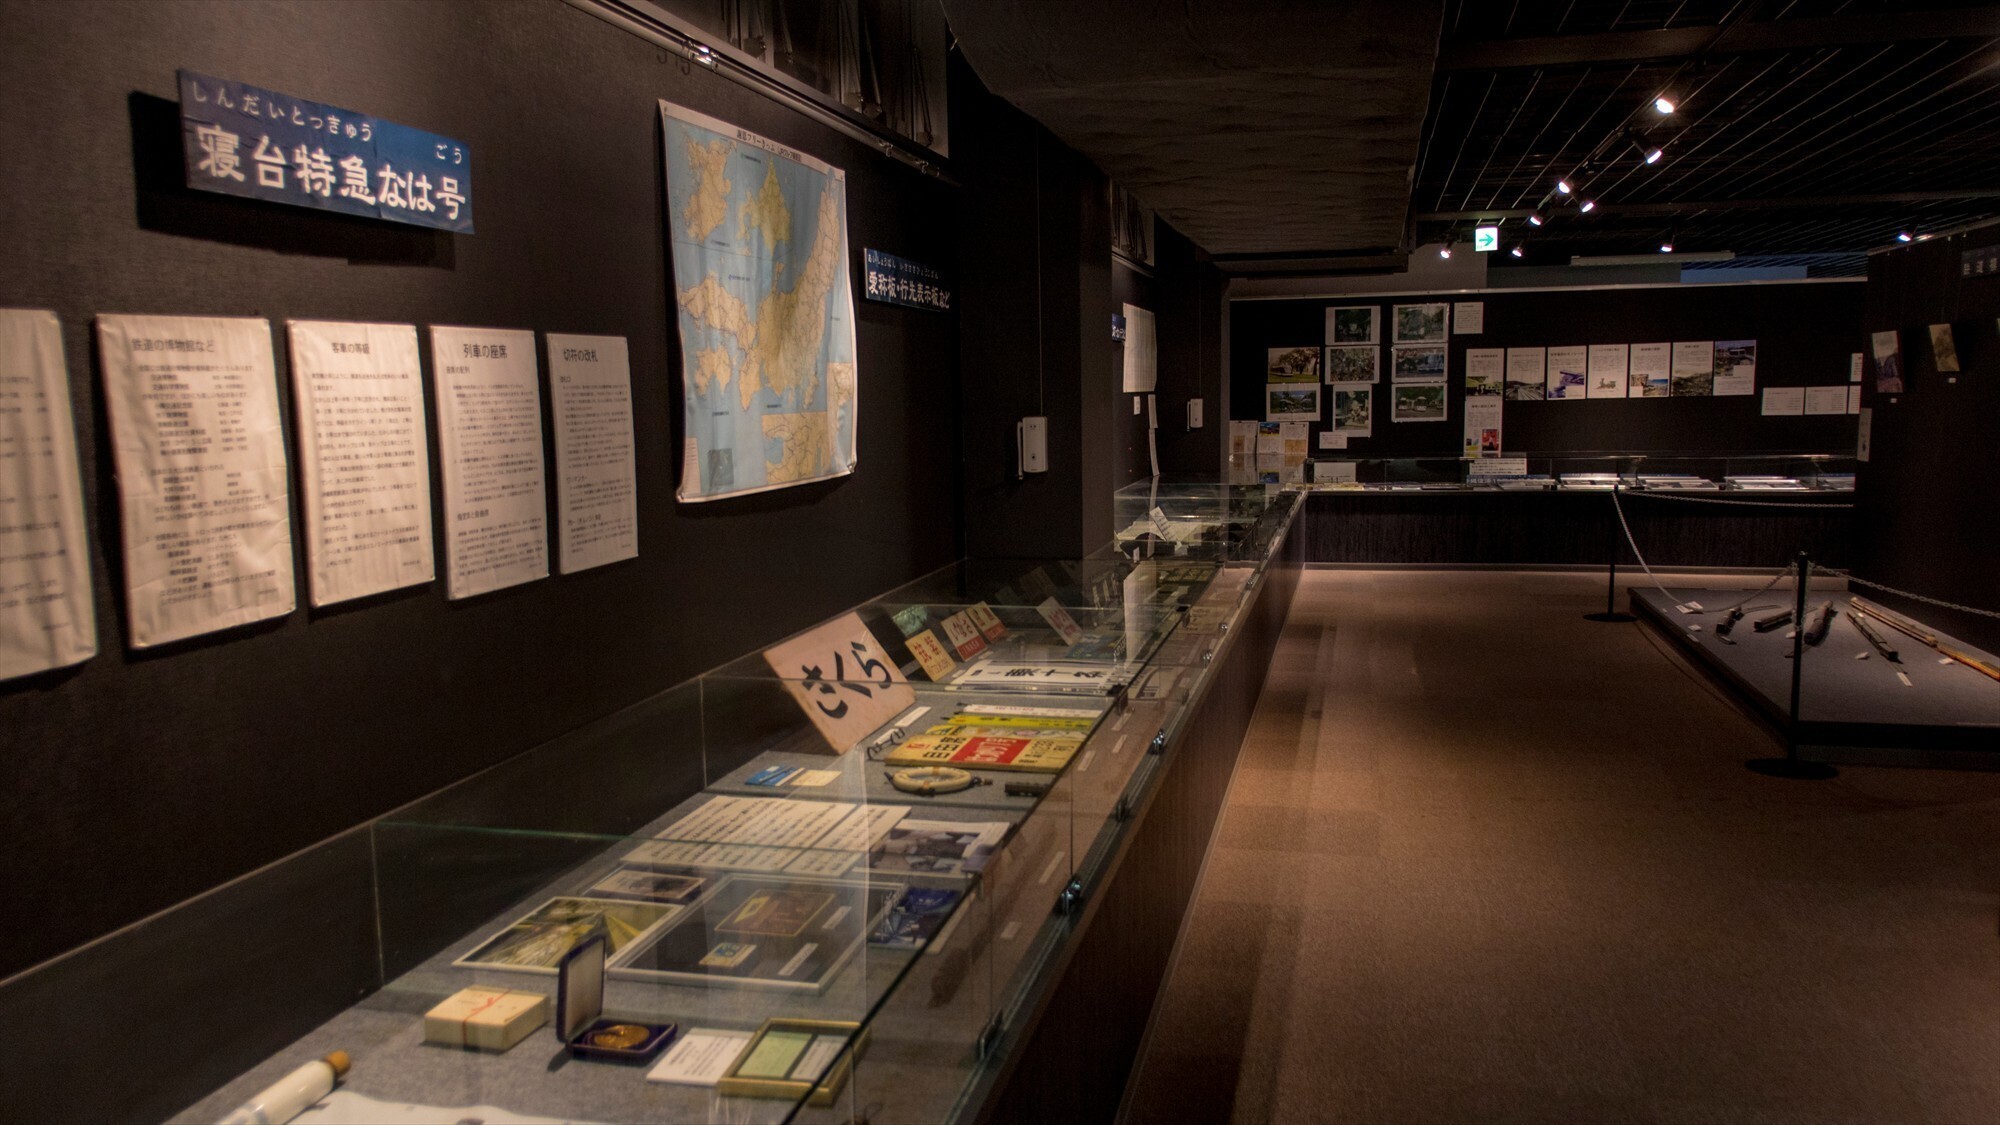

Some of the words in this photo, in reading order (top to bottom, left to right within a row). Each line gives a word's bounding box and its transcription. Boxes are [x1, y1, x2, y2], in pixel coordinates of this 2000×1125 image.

[192, 82, 373, 142] しんだいとっきゅう
[434, 144, 463, 165] ごう
[195, 124, 467, 221] 寝台特急なは号
[131, 337, 216, 353] 鉄道の博物館など
[463, 343, 508, 359] 列車の座席
[563, 348, 599, 363] 切符の改札
[801, 641, 893, 720] さくら
